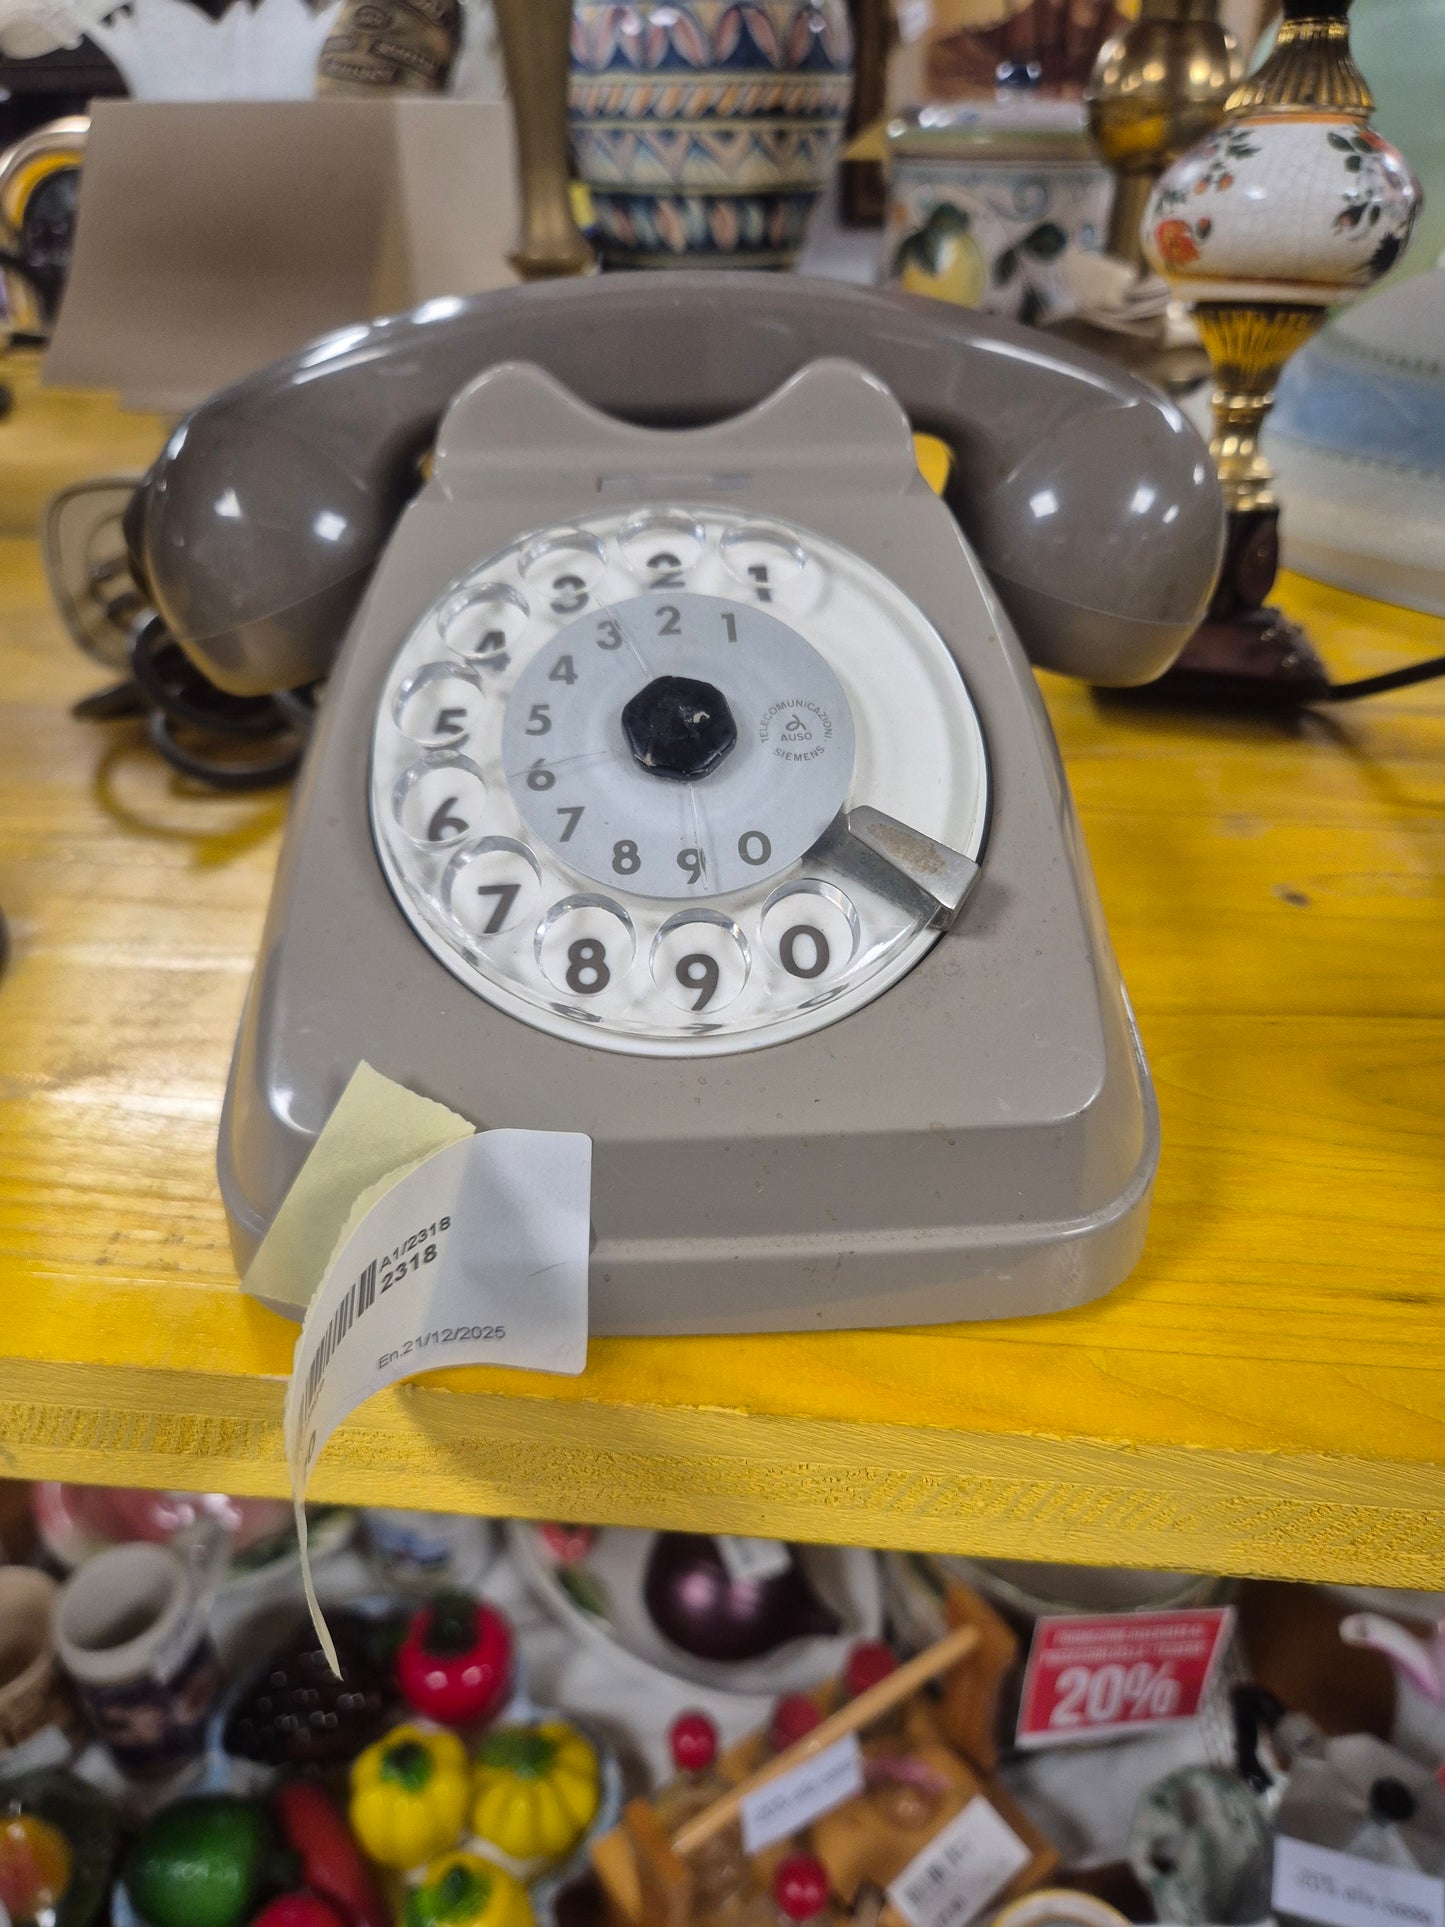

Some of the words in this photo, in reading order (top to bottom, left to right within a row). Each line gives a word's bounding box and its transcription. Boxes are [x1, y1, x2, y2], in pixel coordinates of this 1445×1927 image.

[646, 552, 686, 589] 2
[748, 564, 772, 602] 1
[550, 574, 590, 614] 3
[596, 620, 623, 650] 3
[656, 606, 682, 636] 2
[721, 612, 738, 642] 1
[549, 654, 578, 684] 4
[434, 707, 470, 749] 5
[526, 704, 552, 736] 5
[780, 732, 813, 742] AUSO
[773, 745, 825, 762] SIEMENS
[526, 760, 556, 792] 6
[428, 796, 470, 842] 6
[556, 806, 585, 842] 7
[611, 840, 642, 876] 8
[676, 848, 706, 884] 9
[738, 830, 772, 866] 0
[476, 883, 522, 934] 7
[566, 938, 610, 996] 8
[778, 924, 830, 979] 0
[675, 953, 720, 1012] 9
[378, 1216, 452, 1273] A1/2318
[381, 1243, 438, 1294] 2318
[1047, 1661, 1182, 1729] 20%
